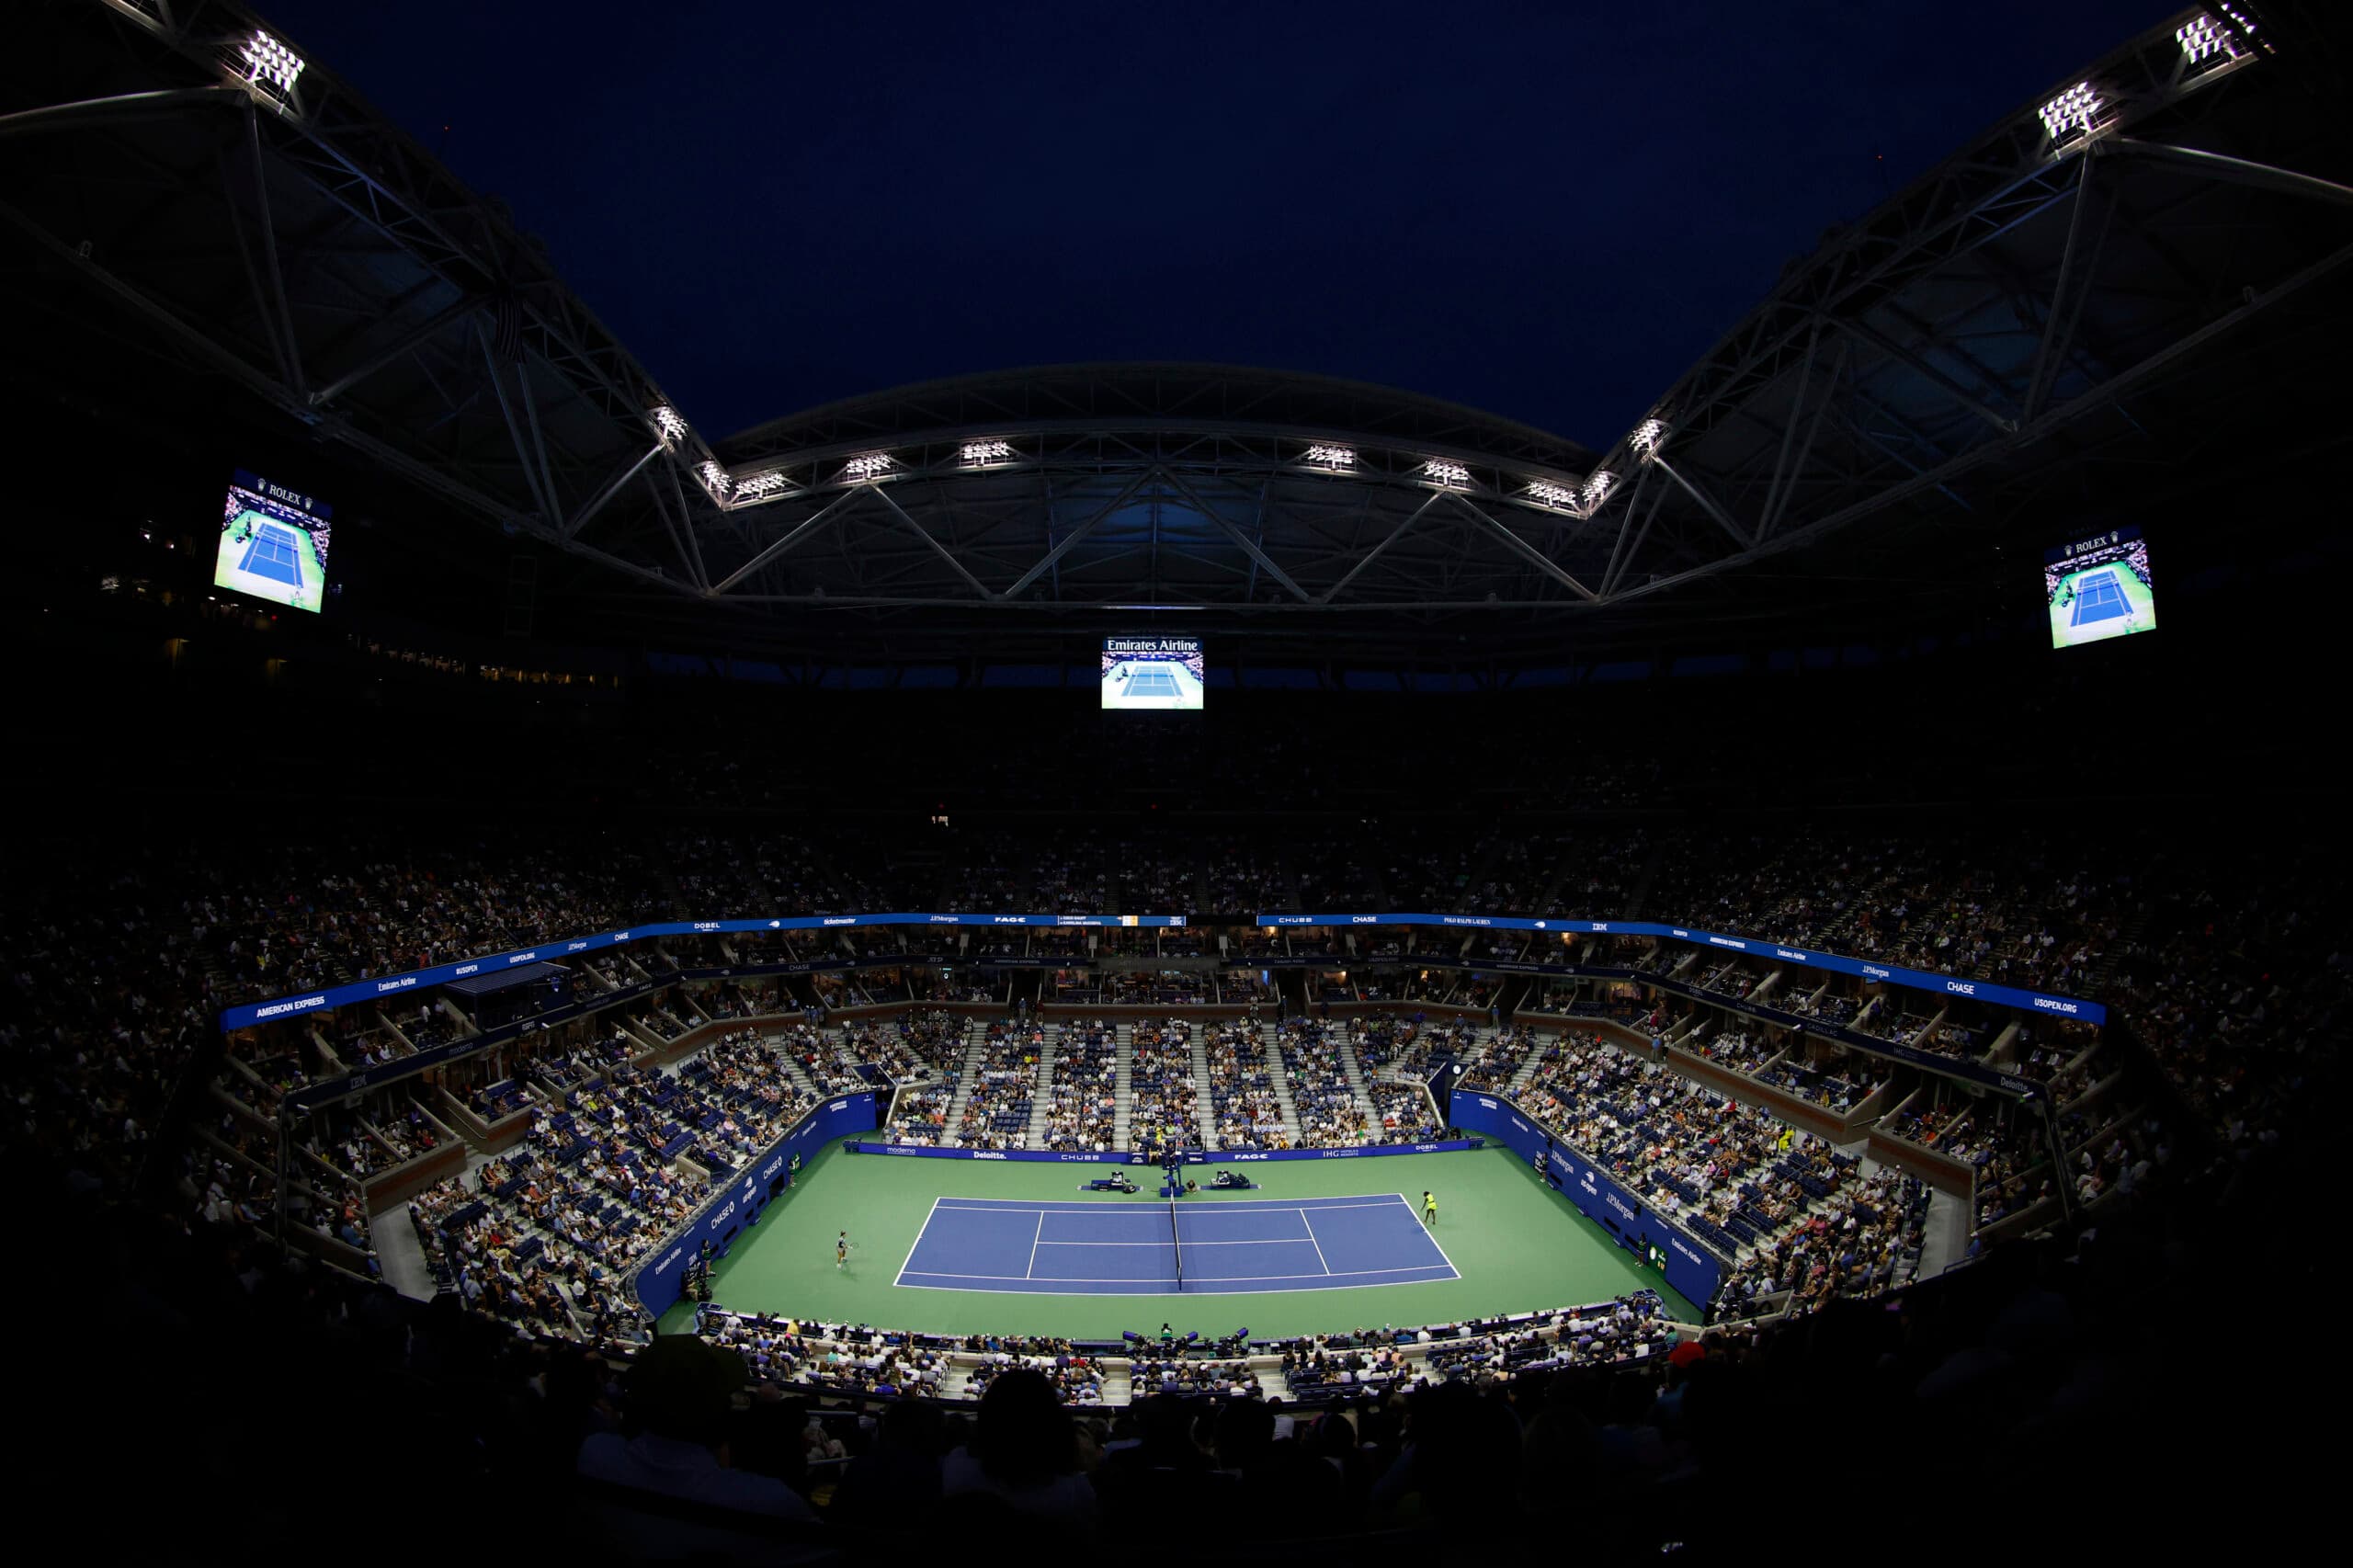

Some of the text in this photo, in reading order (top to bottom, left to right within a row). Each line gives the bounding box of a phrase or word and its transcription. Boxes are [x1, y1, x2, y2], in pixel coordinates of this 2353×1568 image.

[268, 483, 301, 506] ROLEX
[2075, 536, 2108, 553] ROLEX
[1108, 639, 1198, 651] Emirates Airline
[1592, 923, 1608, 931] IBM
[614, 932, 630, 941] CHASE
[509, 952, 535, 963] USOPEN.ORG
[378, 976, 416, 992] Emirates Airline
[1947, 981, 1974, 994] CHASE
[256, 995, 325, 1018] AMERICAN EXPRESS
[2034, 997, 2077, 1014] USOPEN.ORG
[973, 1151, 1007, 1160] Deloitte.
[763, 1159, 779, 1180] CHASE
[710, 1206, 730, 1230] CHASE
